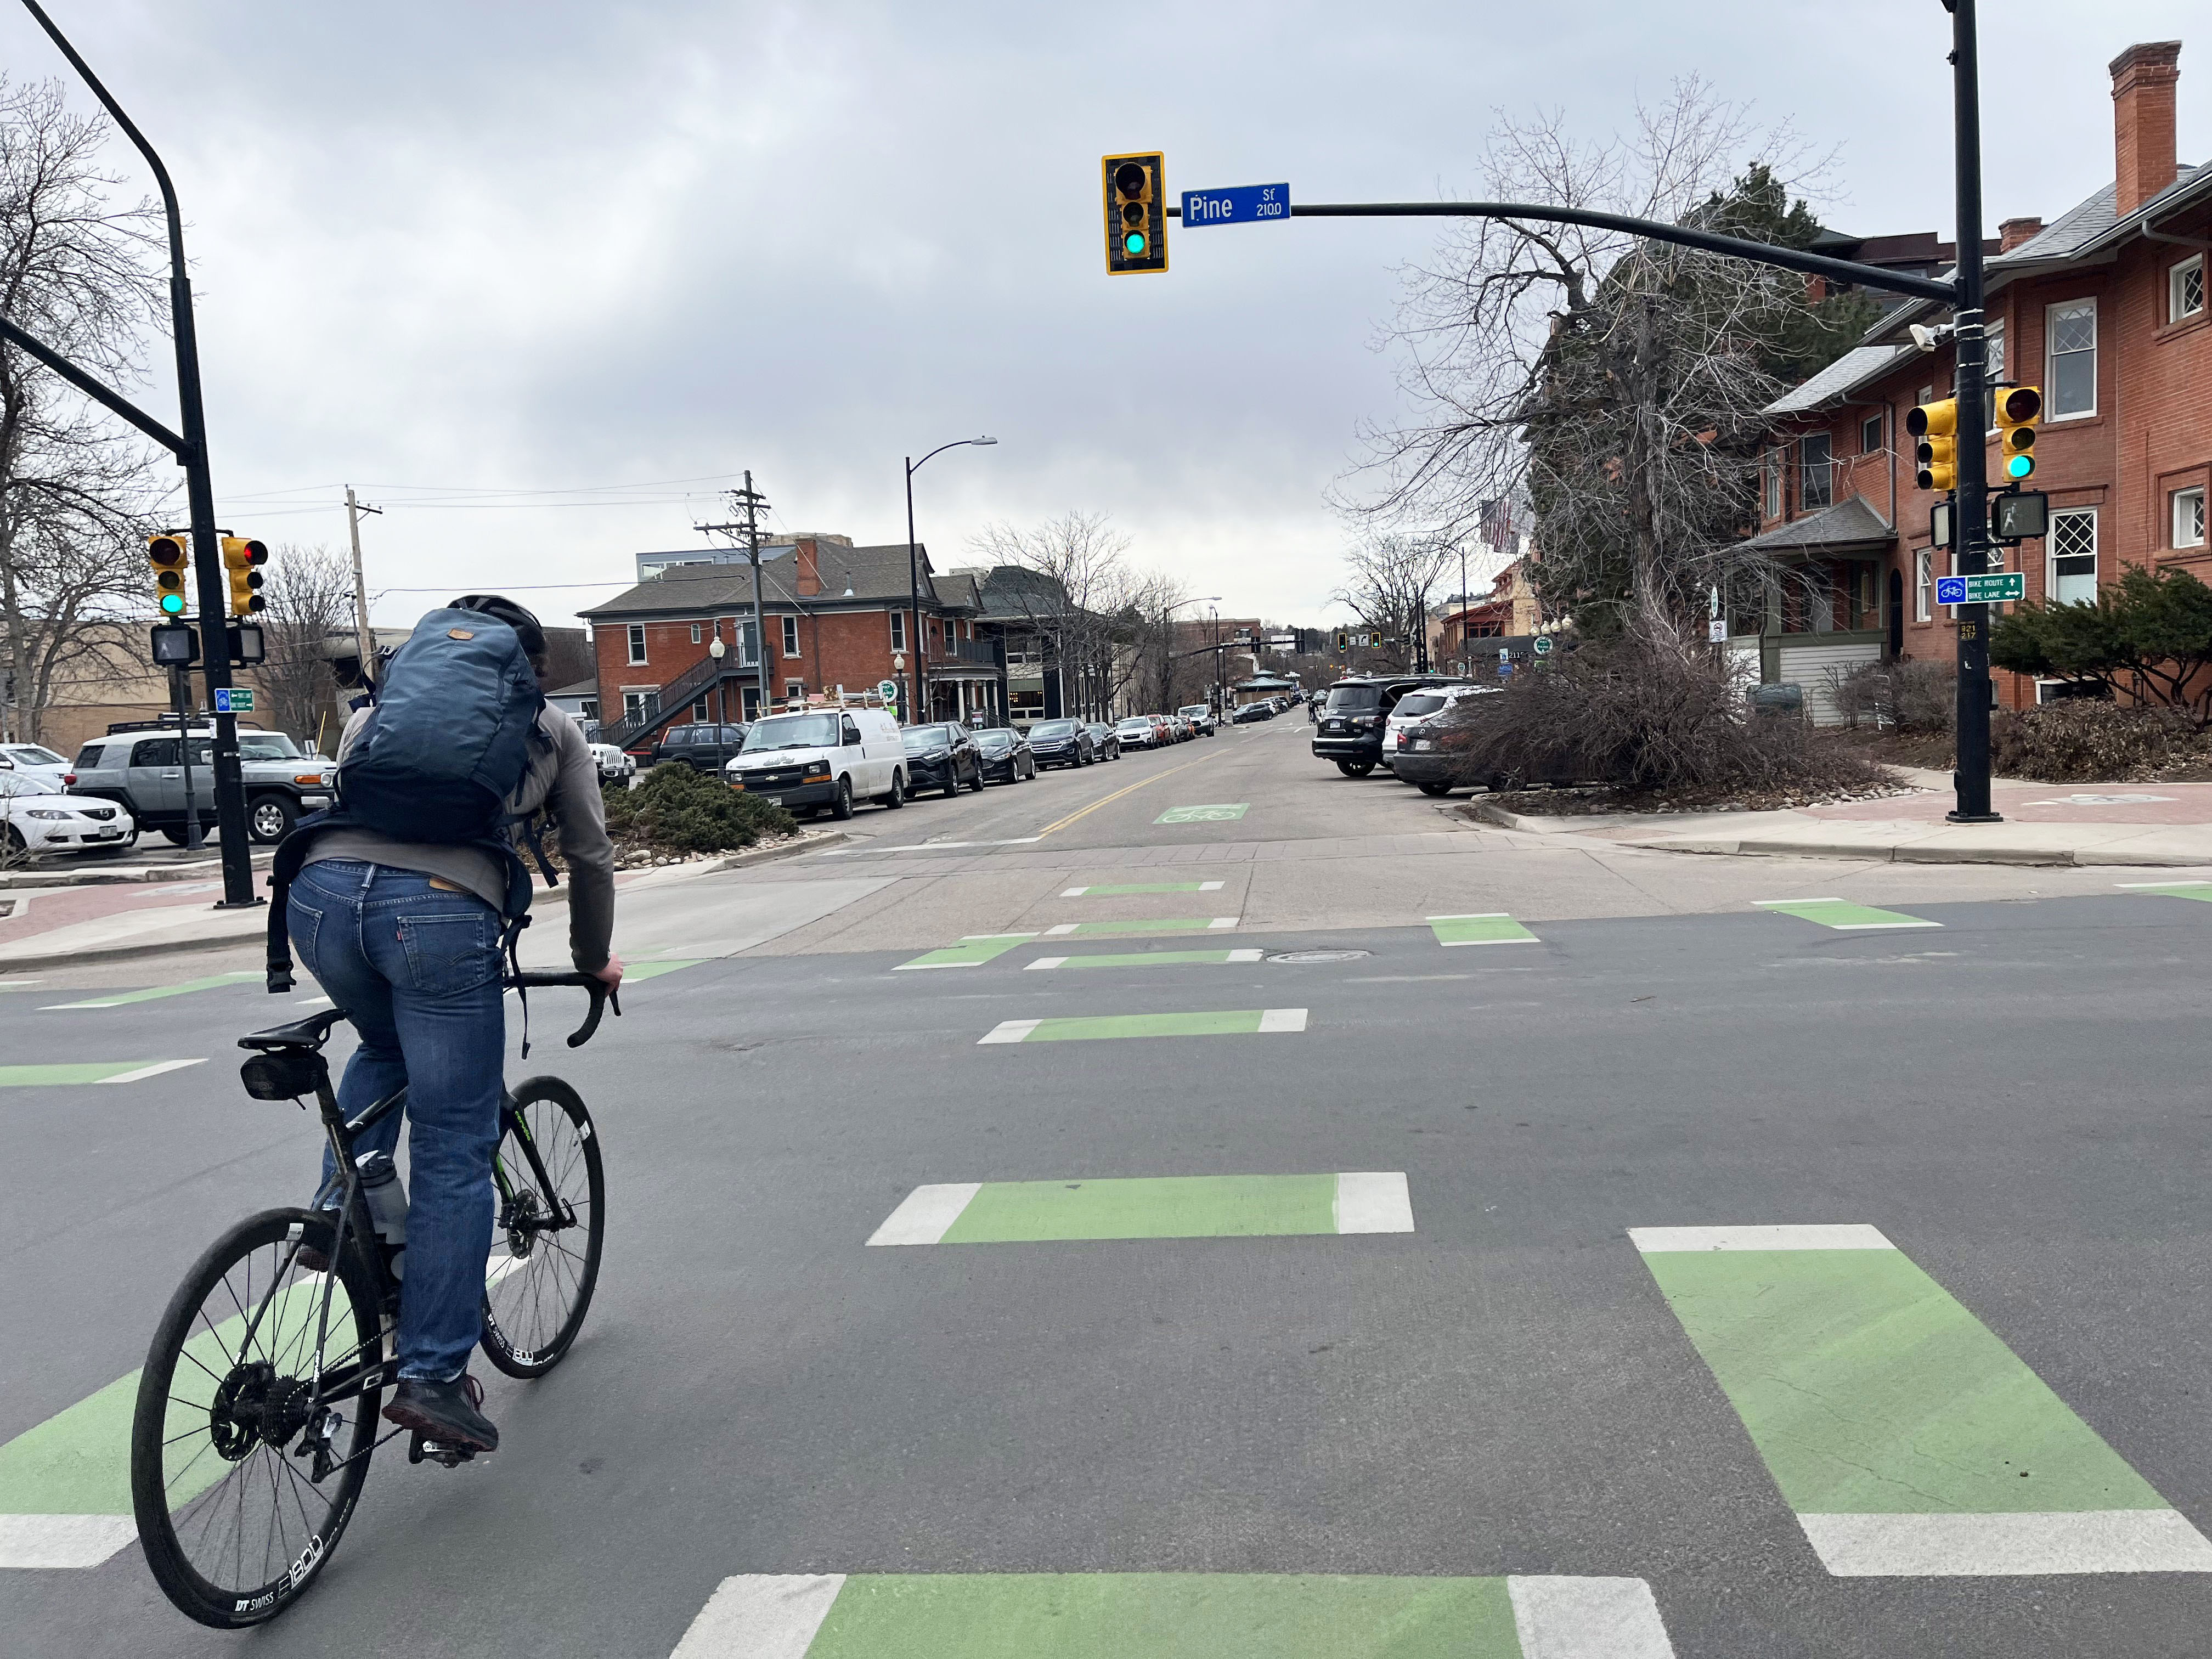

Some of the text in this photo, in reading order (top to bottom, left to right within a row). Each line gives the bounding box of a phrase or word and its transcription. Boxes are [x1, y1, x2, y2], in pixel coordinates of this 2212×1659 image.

[1190, 188, 1276, 221] Pine St
[1256, 202, 1282, 217] 2100
[235, 1600, 250, 1612] DT
[250, 1592, 274, 1611] SWISS
